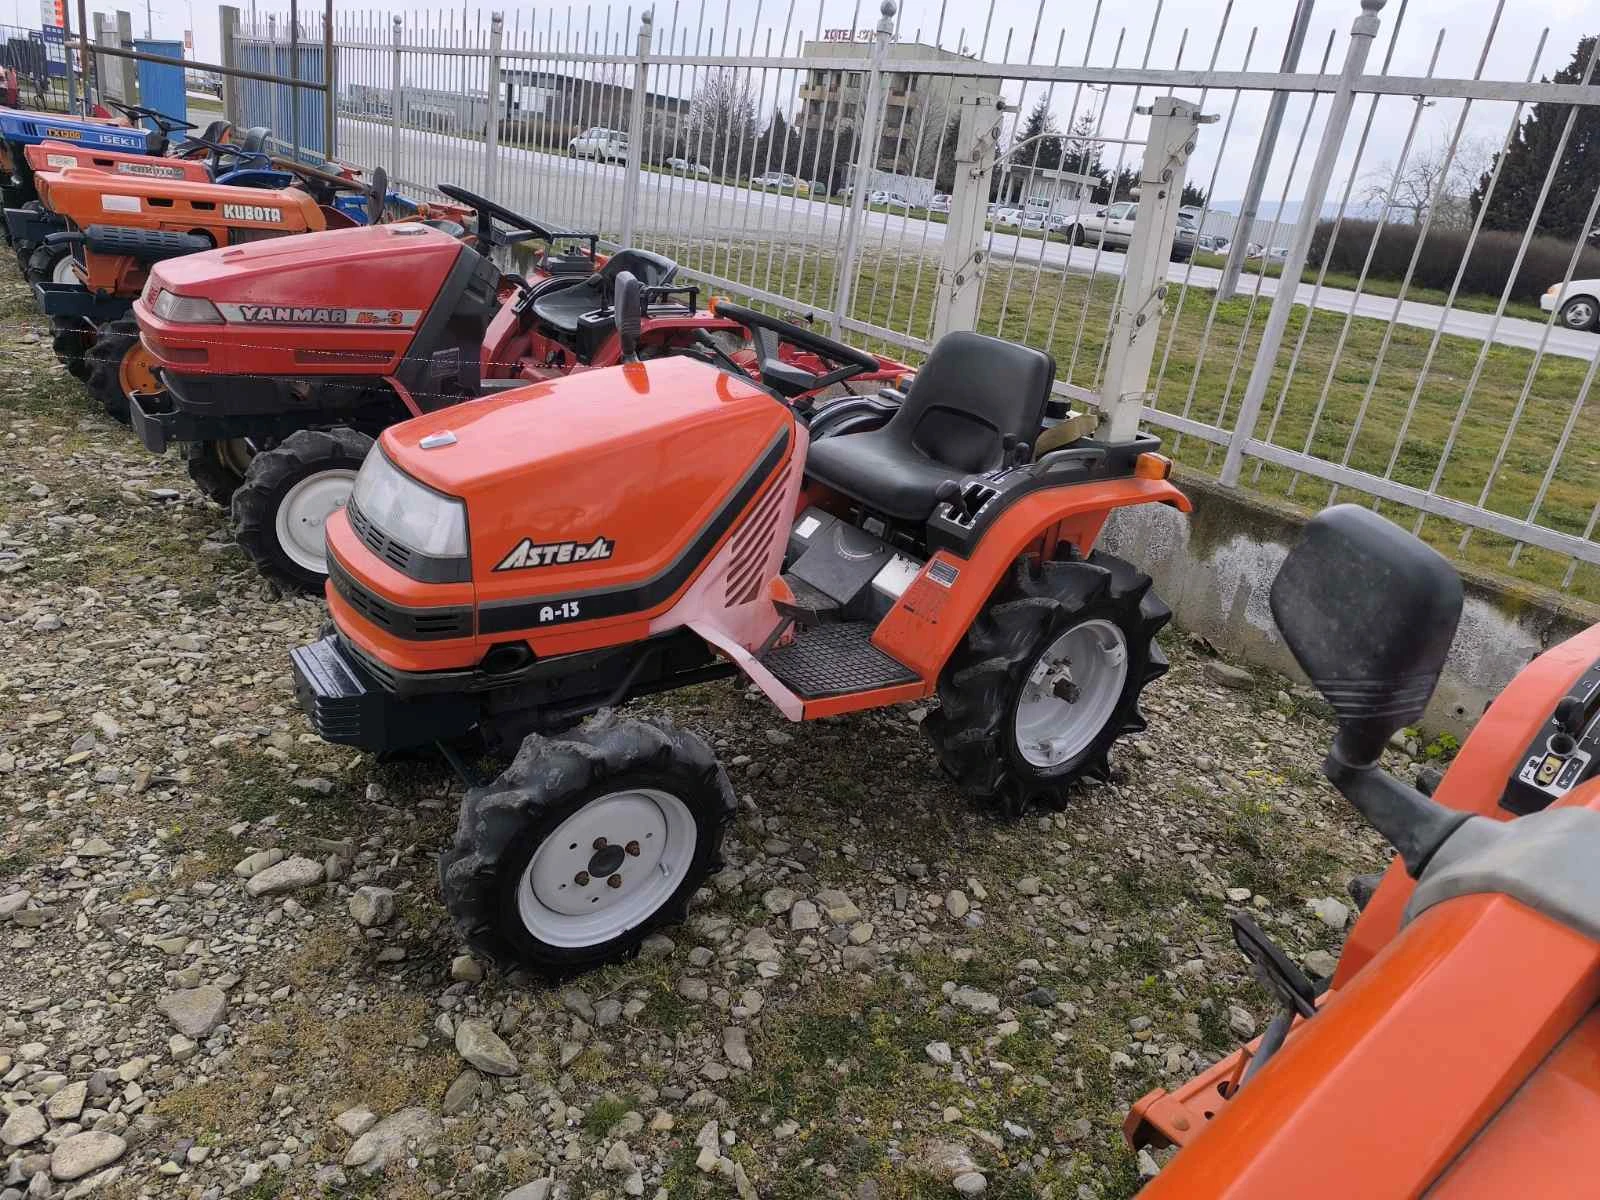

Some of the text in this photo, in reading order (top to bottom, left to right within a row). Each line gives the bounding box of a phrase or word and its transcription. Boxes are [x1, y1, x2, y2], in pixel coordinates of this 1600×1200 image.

[224, 204, 281, 222] KUBOTA
[240, 306, 347, 323] YANMAR
[540, 601, 580, 622] A-13
